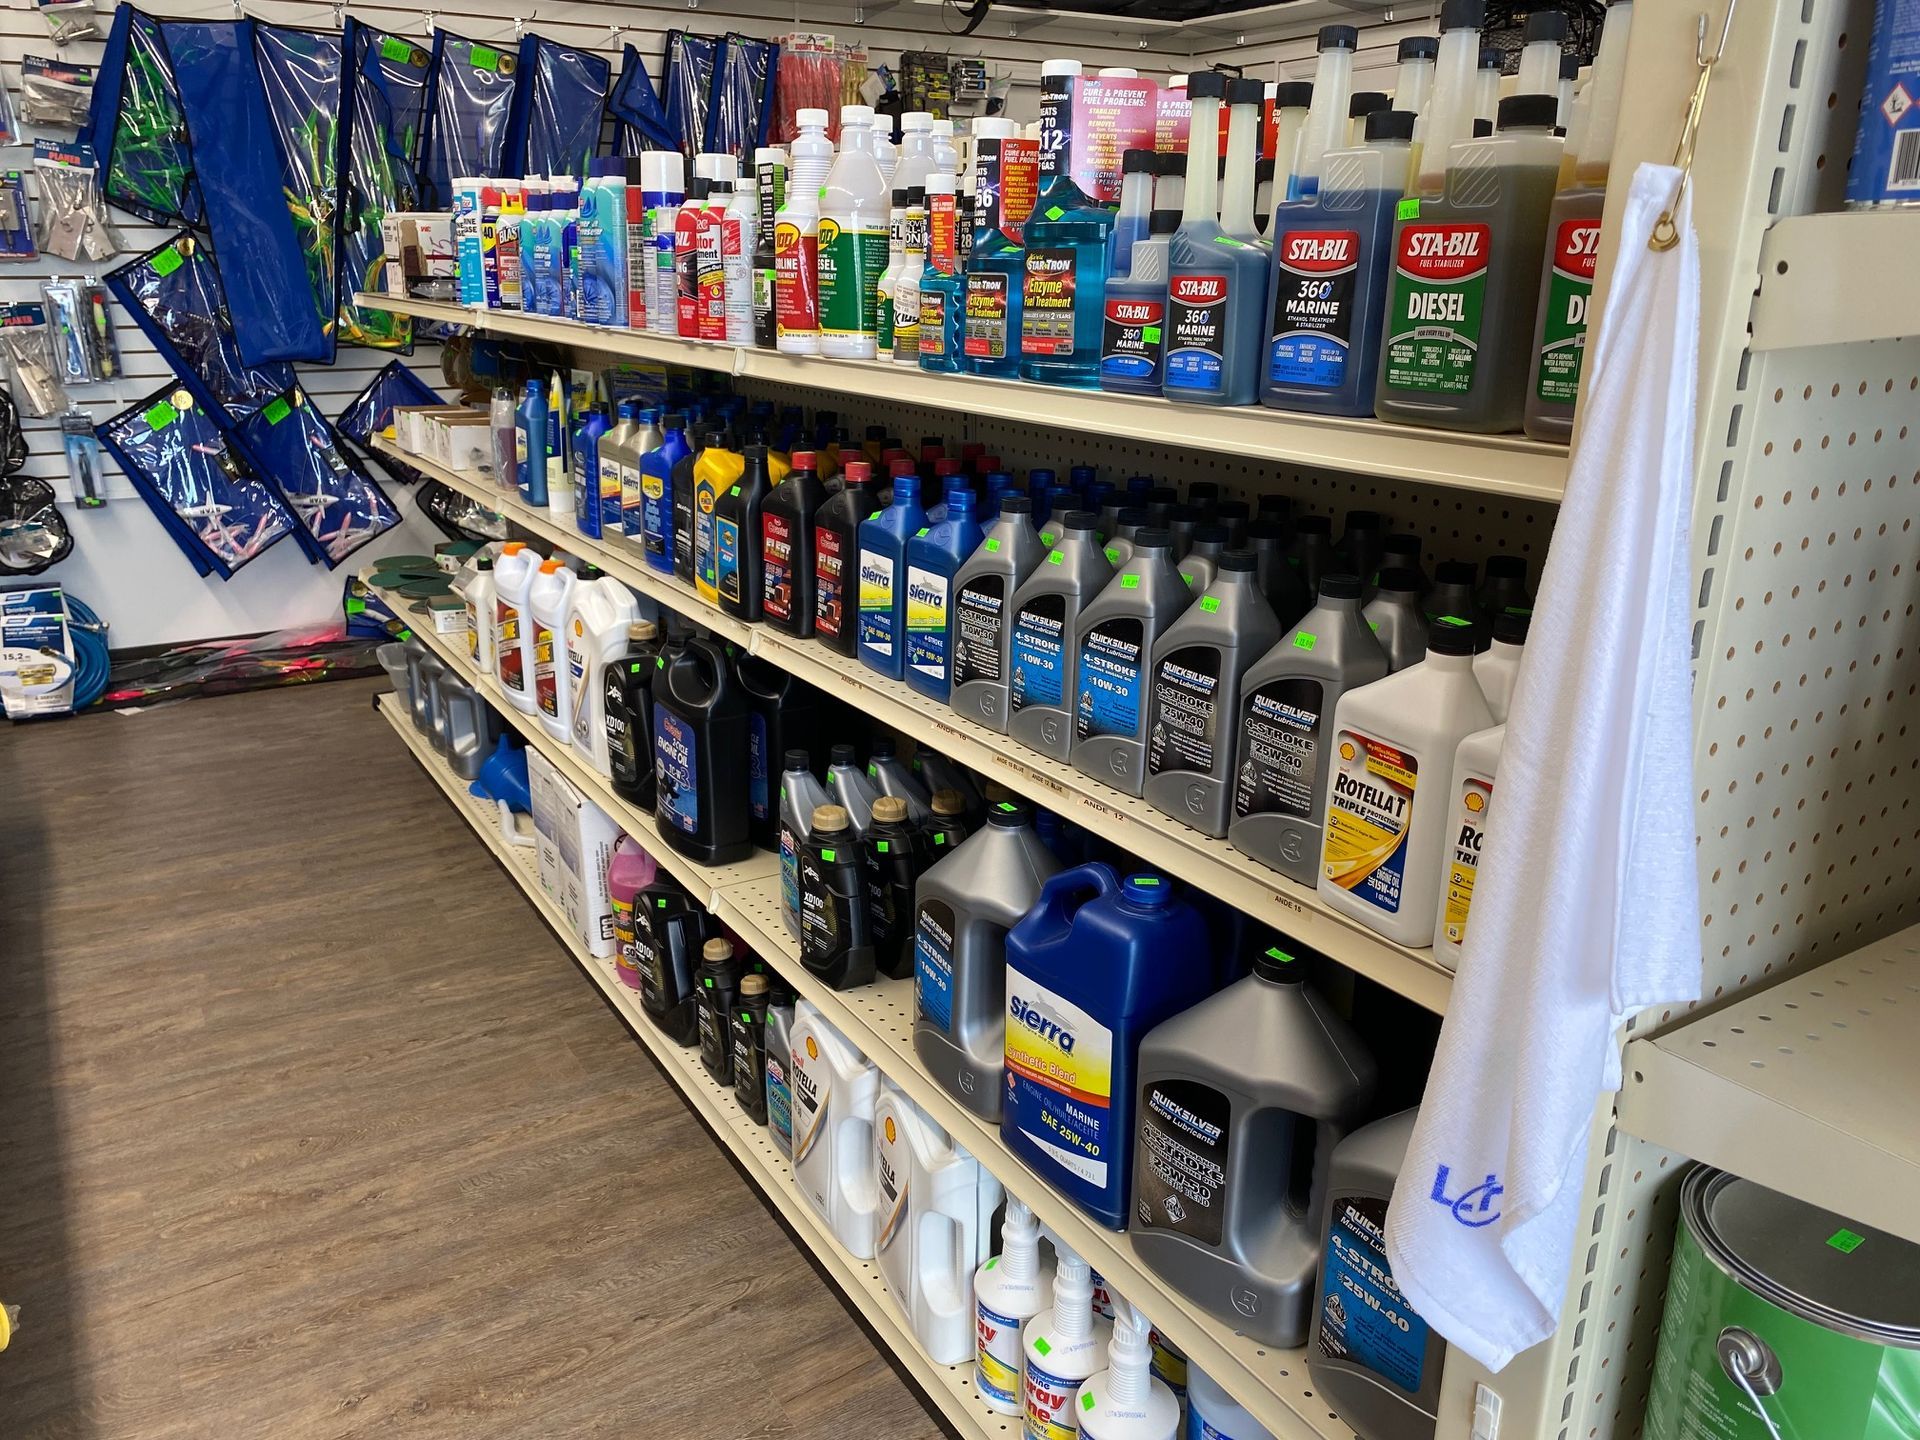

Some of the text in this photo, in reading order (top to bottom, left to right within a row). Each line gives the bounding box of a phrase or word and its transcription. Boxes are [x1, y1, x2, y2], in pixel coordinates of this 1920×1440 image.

[1083, 88, 1103, 97] CURE
[1114, 90, 1147, 98] PREVENT
[1083, 97, 1101, 105] FUEL
[1288, 238, 1349, 262] STA-BIL
[1406, 231, 1480, 257] STA-BIL
[1419, 259, 1465, 268] FUEL STABILIZER
[1029, 278, 1062, 296] Enzyme
[1178, 280, 1219, 296] STA-BIL
[969, 293, 994, 307] Enzyme
[1035, 296, 1071, 308] Treatment
[1286, 300, 1340, 315] MARINE
[1407, 292, 1466, 321] DIESEL
[1116, 304, 1150, 320] STA-BIL
[1176, 324, 1215, 336] MARINE
[1116, 339, 1144, 349] MARINE
[961, 598, 998, 613] Marine Lubricants
[962, 589, 1002, 606] QUICKSILVER
[957, 606, 1000, 628] 4-STROKE
[1020, 611, 1063, 630] QUICKSILVER
[965, 624, 994, 641] 10W-30
[1019, 620, 1059, 637] Marine Lubricants
[1015, 631, 1061, 652] 4-STROKE
[1088, 641, 1135, 661] Marine Lubricants
[1089, 631, 1139, 654] QUICKSILVER
[1023, 653, 1054, 670] 10W-30
[1083, 653, 1137, 678] 4-STROKE
[1160, 672, 1211, 695] Marine Lubricants
[1163, 661, 1216, 688] QUICKSILVER
[1092, 676, 1128, 697] 10W-30
[1155, 683, 1213, 713] 4-STROKE
[1254, 694, 1317, 724] QUICKSILVER
[936, 723, 956, 735] ANDE
[1165, 706, 1204, 730] 25W-40
[1251, 705, 1311, 732] Marine Lubricants
[1245, 717, 1314, 752] 4-STROKE
[658, 736, 689, 768] ENGINE OIL
[996, 755, 1008, 766] ANDE
[1254, 742, 1303, 770] 25W-40
[1384, 761, 1394, 770] CODE
[1031, 773, 1044, 783] ANDE
[1335, 772, 1407, 817] ROTELLA T
[1083, 799, 1124, 821] ANDE 12
[1333, 795, 1367, 817] TRIPLE
[1366, 809, 1399, 829] PROTECTION
[1374, 880, 1399, 899] 15W-40
[1376, 869, 1400, 888] ENGINE OIL
[803, 891, 825, 910] XD100
[1275, 895, 1293, 909] ANDE
[916, 933, 953, 975] 4-STROKE
[921, 961, 947, 992] 10W-30
[1010, 994, 1077, 1053] Sierra
[1007, 1043, 1048, 1072] Synthetic
[1049, 1063, 1077, 1085] Blend
[1022, 1079, 1043, 1103] ENGINE
[1065, 1102, 1100, 1131] MARINE
[1148, 1101, 1216, 1147] Marine Lubricants
[1151, 1089, 1222, 1140] QUICKSILVER
[1041, 1110, 1100, 1157] SAE 25W-40
[1143, 1126, 1224, 1185] 4-STROKE
[1152, 1154, 1212, 1201] 25W-50
[1201, 1175, 1219, 1190] OIL
[1340, 1216, 1369, 1243] Marine
[1334, 1249, 1401, 1304] MARINE ENGINE
[1342, 1275, 1410, 1333] 25W-40
